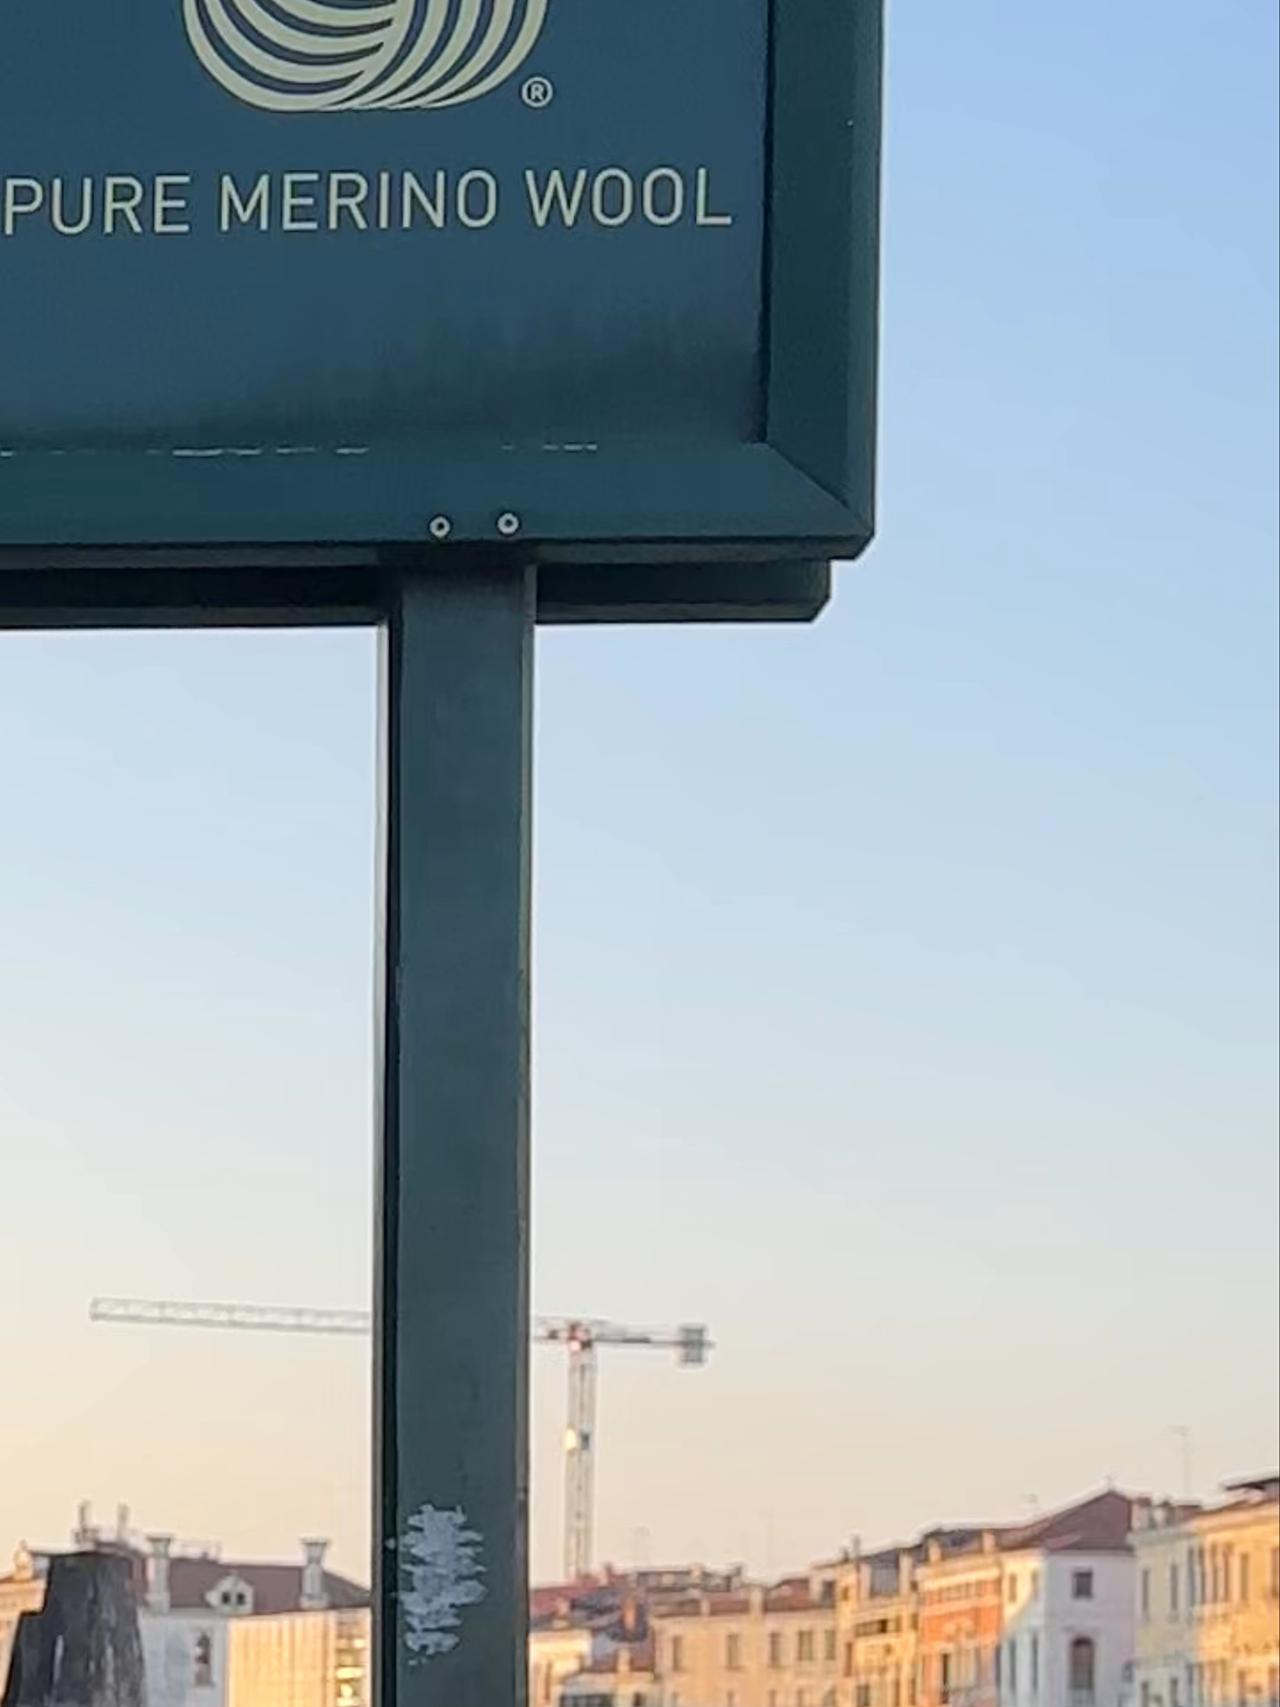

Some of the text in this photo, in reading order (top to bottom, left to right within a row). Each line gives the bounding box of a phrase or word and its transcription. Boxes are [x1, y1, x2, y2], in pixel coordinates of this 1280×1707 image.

[3, 166, 733, 236] PURE MERINO WOOL
